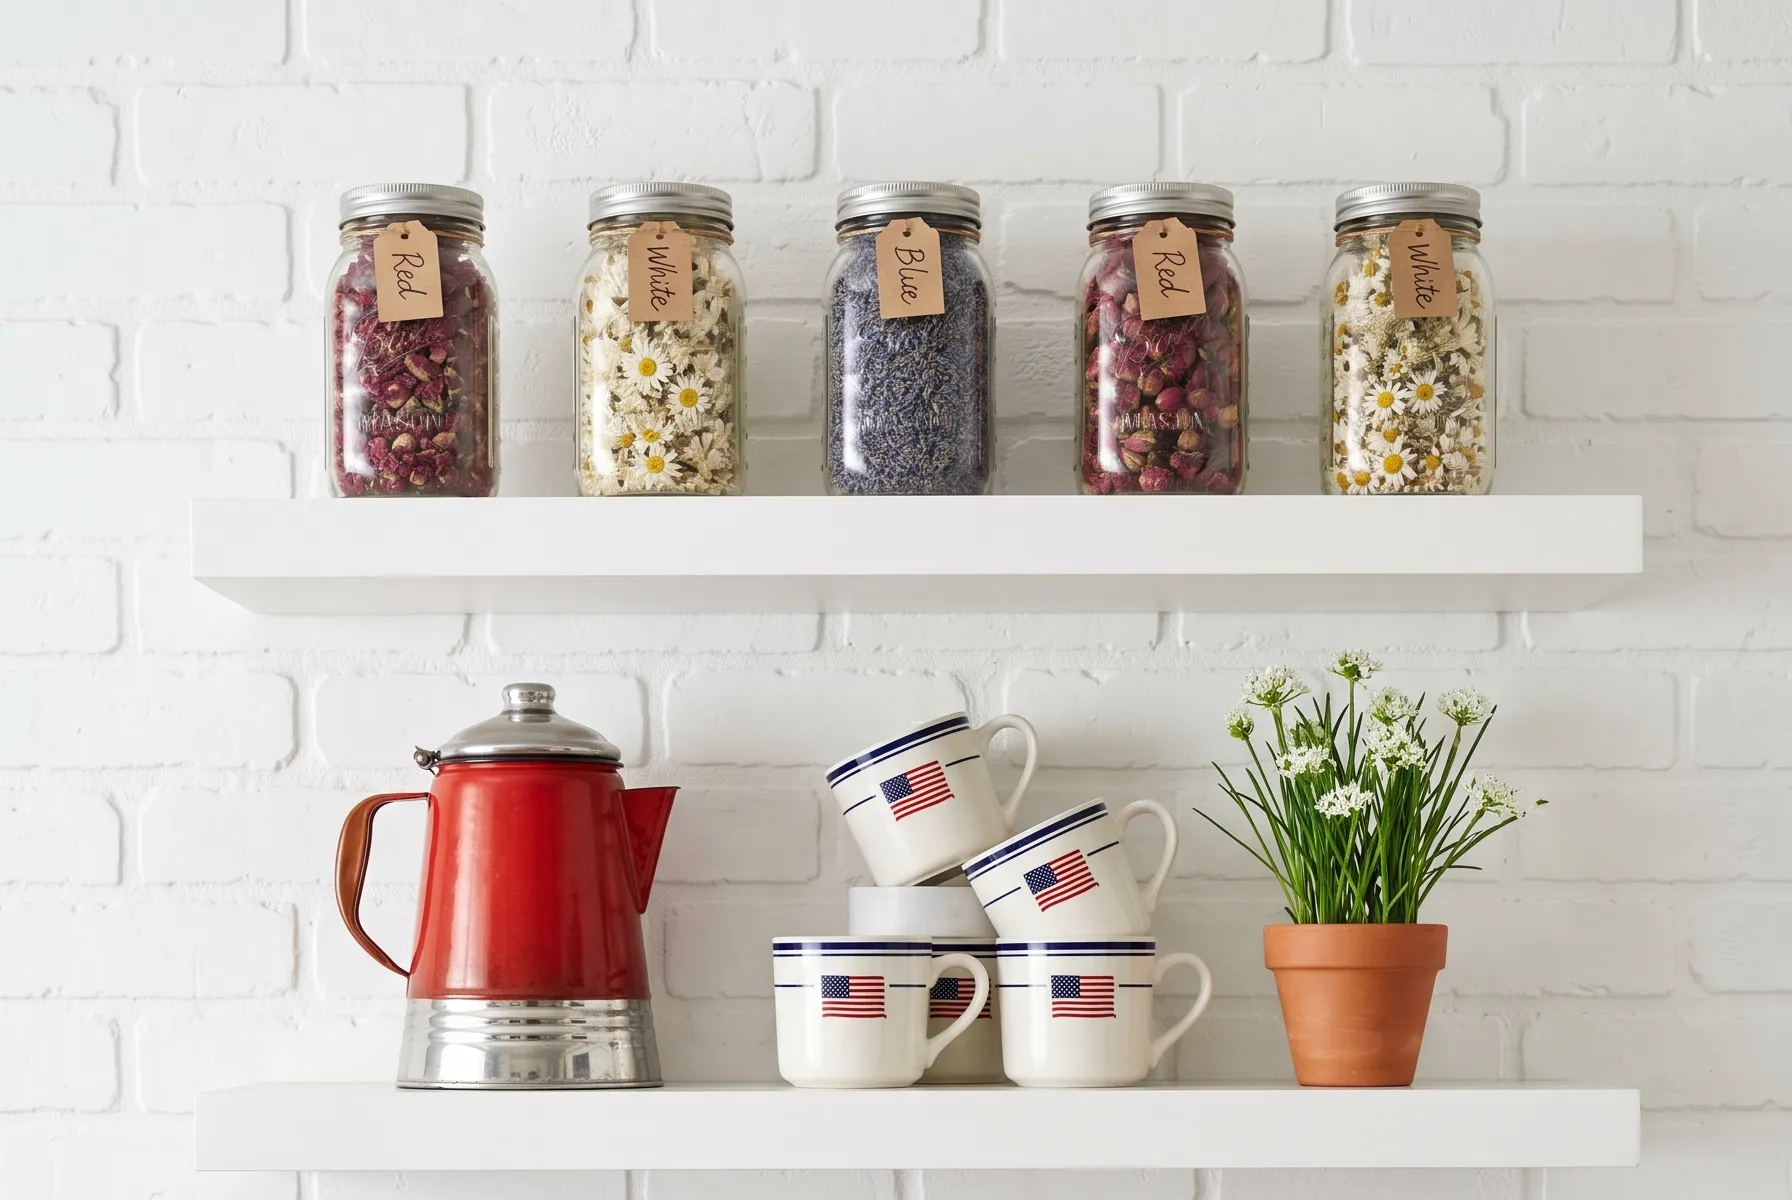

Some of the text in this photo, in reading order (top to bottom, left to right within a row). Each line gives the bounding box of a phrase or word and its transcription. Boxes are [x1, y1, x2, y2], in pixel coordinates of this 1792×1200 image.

[391, 252, 428, 300] Red
[646, 246, 678, 312] White
[894, 246, 928, 305] Blue
[1152, 250, 1190, 299] Red
[1407, 243, 1441, 310] White
